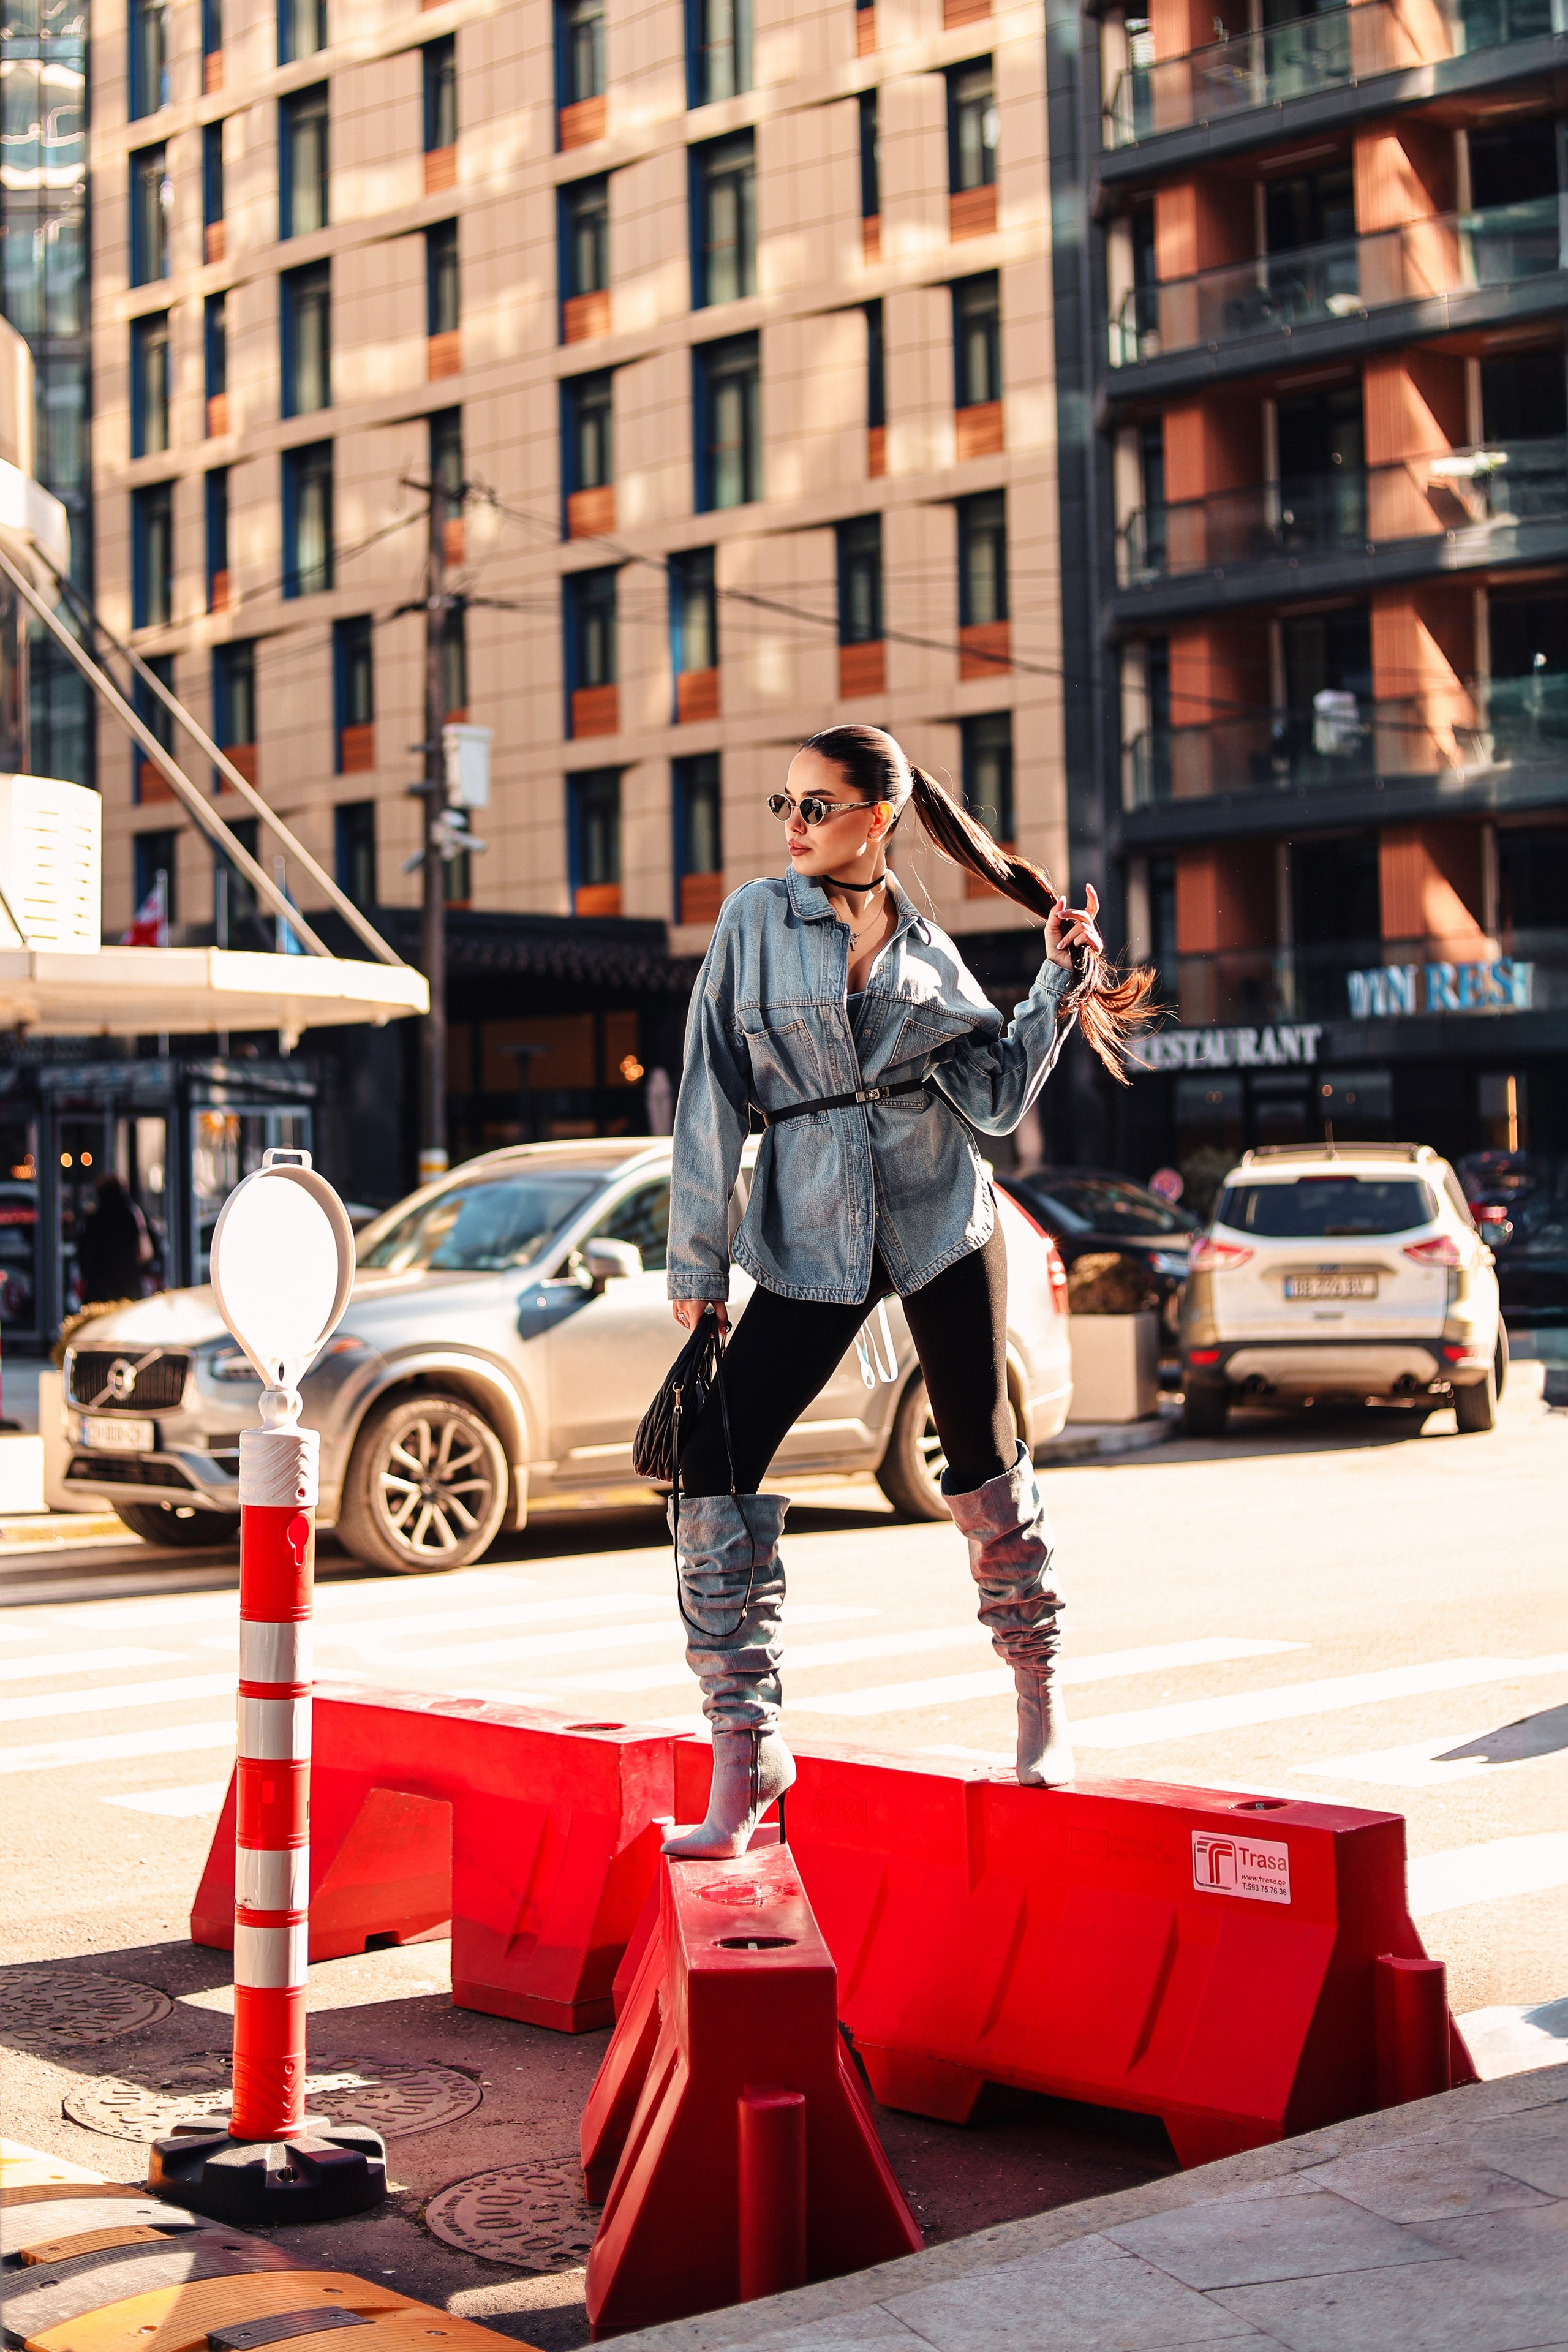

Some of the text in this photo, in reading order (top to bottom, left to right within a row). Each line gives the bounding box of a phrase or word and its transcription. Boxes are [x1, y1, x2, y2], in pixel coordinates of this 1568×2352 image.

[812, 1798, 864, 1826] NOVA
[1238, 1847, 1287, 1872] Trasa
[1242, 1874, 1286, 1887] www.trasa.ge
[1242, 1882, 1259, 1892] T:593
